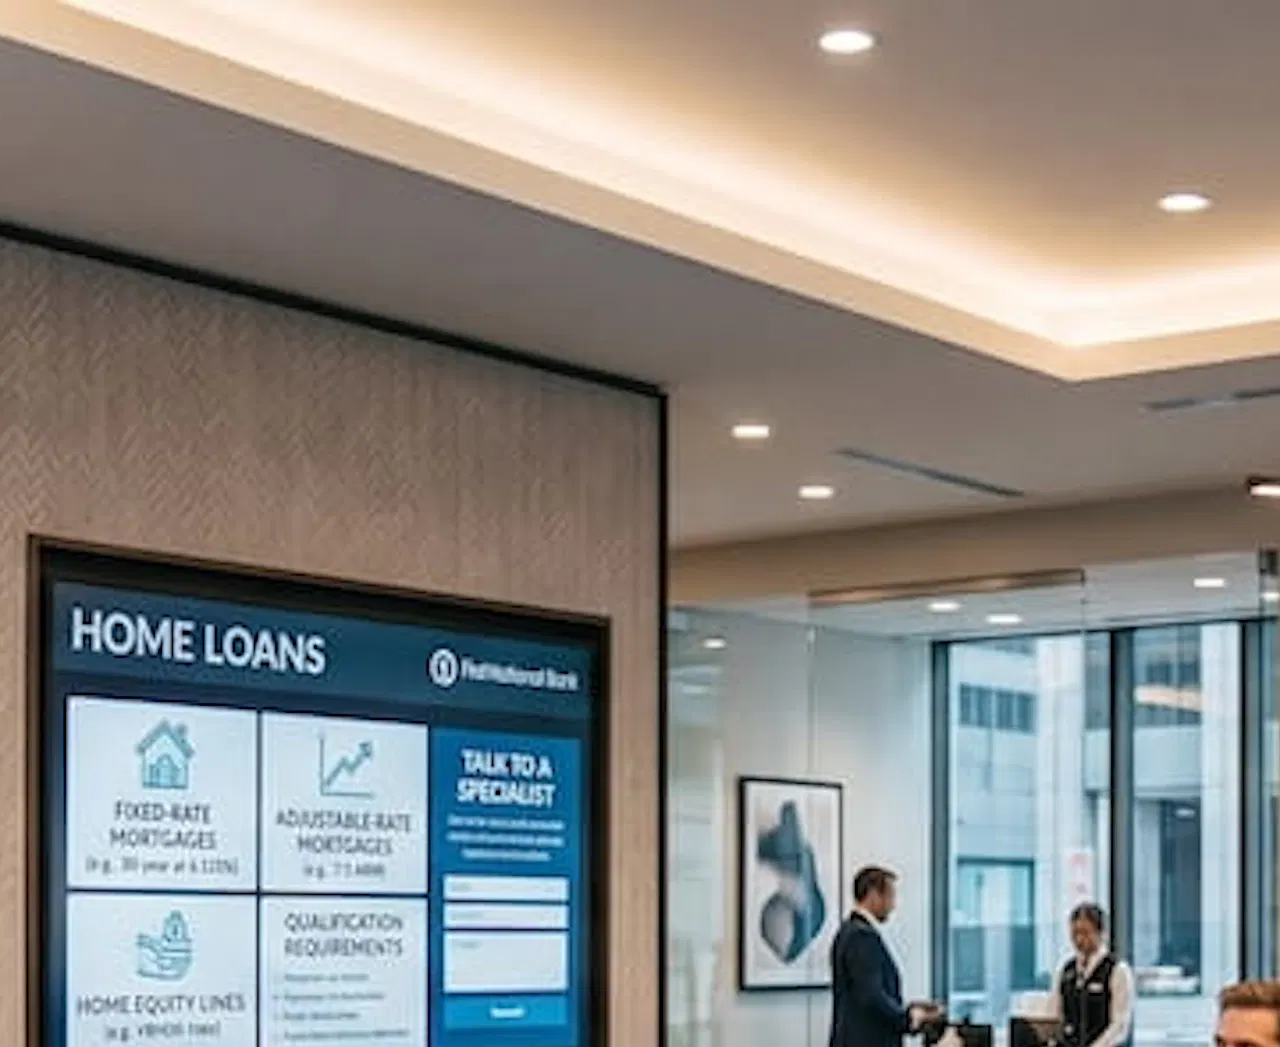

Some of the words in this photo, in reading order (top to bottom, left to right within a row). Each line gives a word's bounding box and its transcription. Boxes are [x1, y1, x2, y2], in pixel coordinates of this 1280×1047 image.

[72, 605, 195, 663] HOME
[204, 623, 327, 675] LOANS
[461, 748, 509, 777] TALK
[511, 751, 535, 779] TO
[536, 755, 553, 780] A
[457, 777, 556, 809] SPECIALIST
[113, 800, 212, 825] FIXED-RATE
[276, 808, 411, 834] ADJUSTABLE-RATE
[108, 826, 217, 851] MORTGAGES
[297, 835, 394, 857] MORTGAGES
[283, 911, 404, 933] QUALIFICATION
[283, 937, 404, 958] REQUIREMENTS
[77, 994, 130, 1016] HOME
[133, 993, 196, 1016] EQUITY
[198, 991, 247, 1013] LINES
